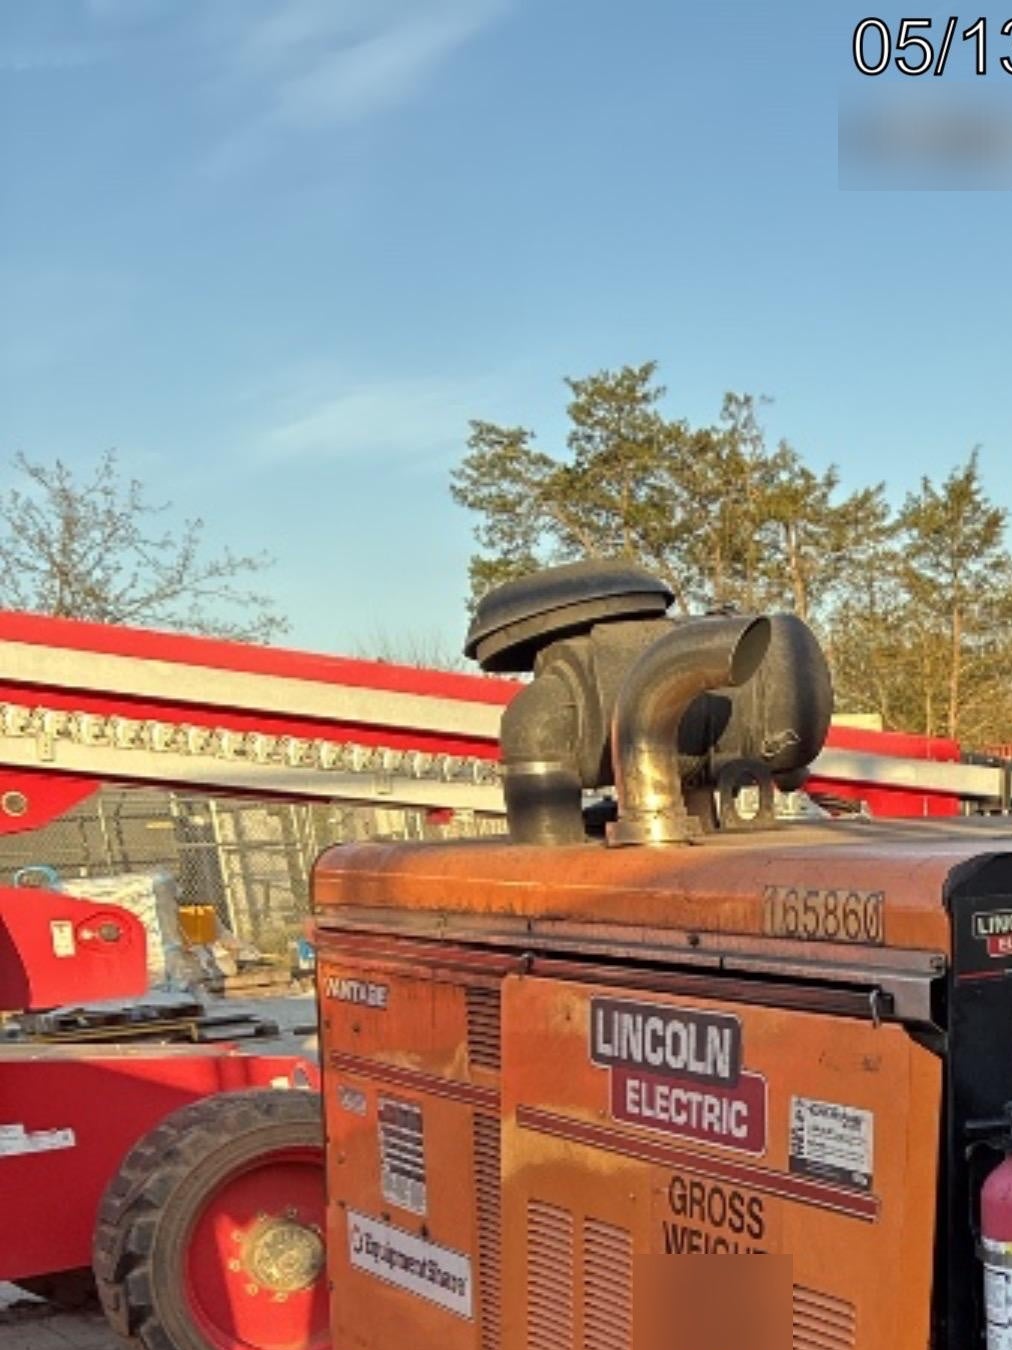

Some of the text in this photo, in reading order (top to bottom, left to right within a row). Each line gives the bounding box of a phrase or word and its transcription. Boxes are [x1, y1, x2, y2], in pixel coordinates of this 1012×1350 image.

[597, 1007, 732, 1078] LINCOLN
[626, 1078, 748, 1138] ELECTRIC
[668, 1175, 765, 1240] GROSS
